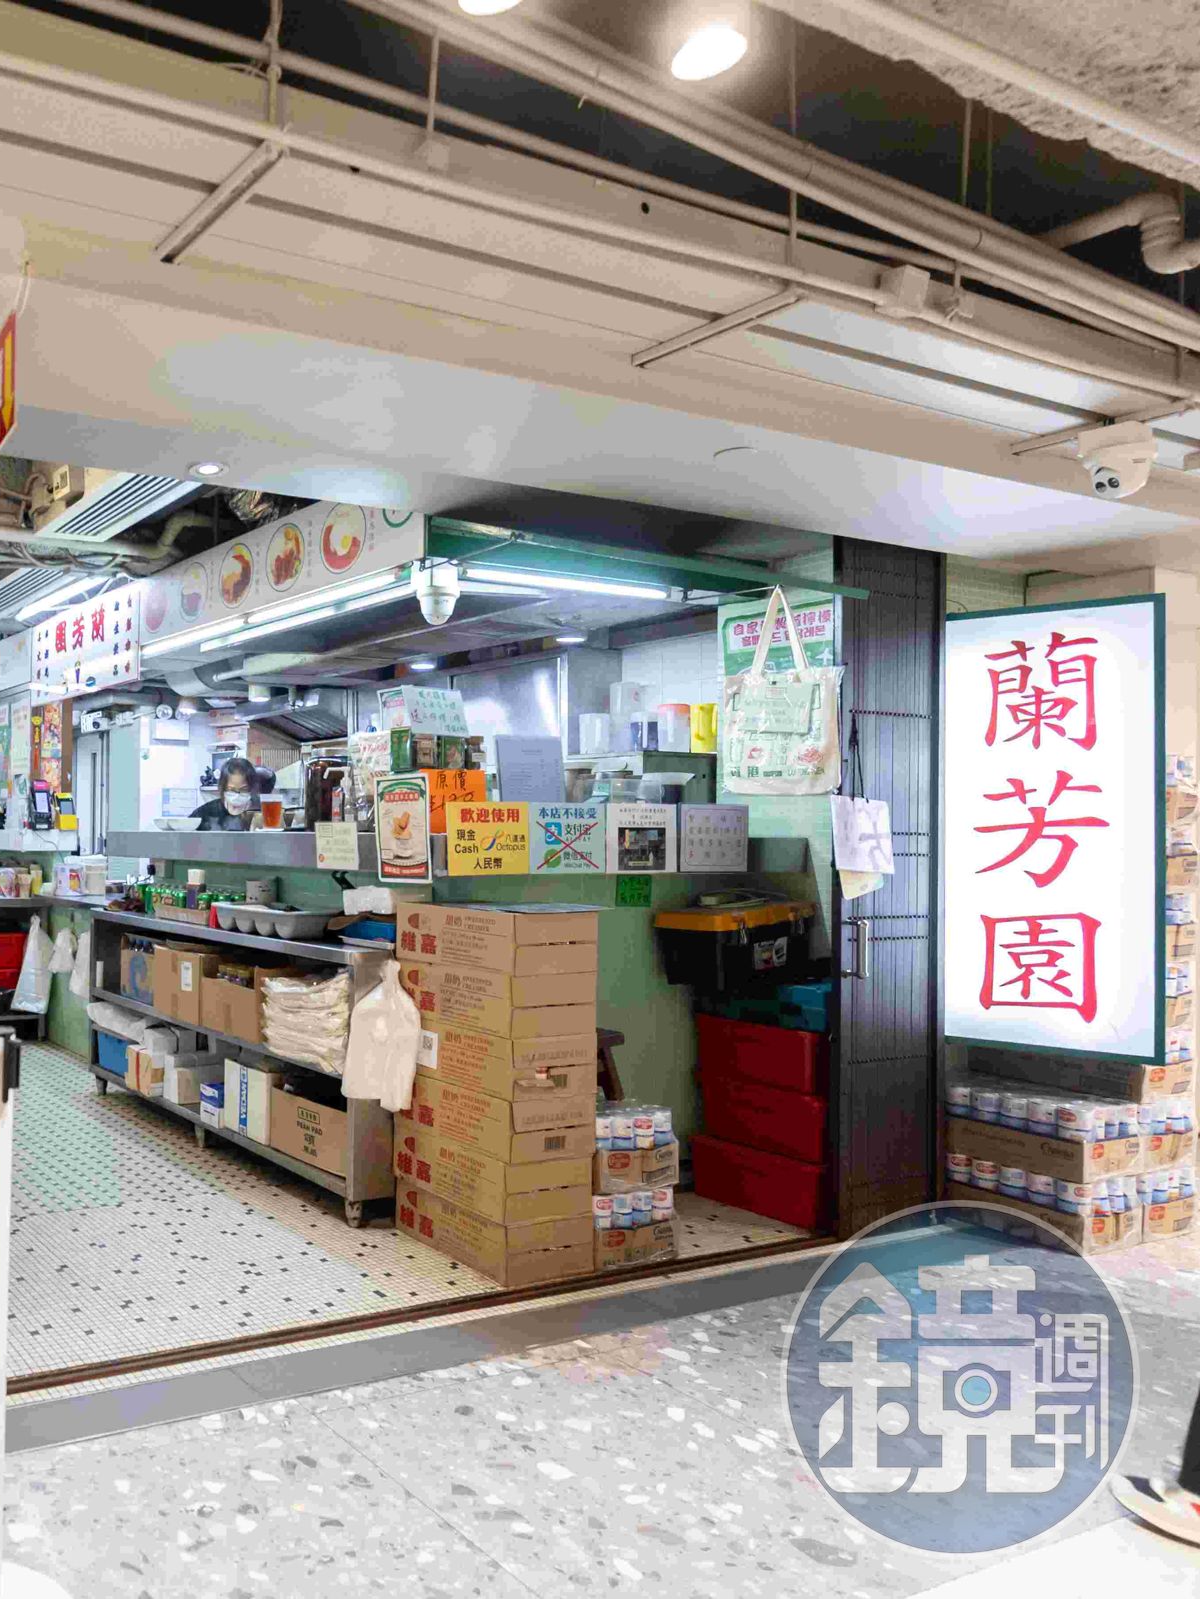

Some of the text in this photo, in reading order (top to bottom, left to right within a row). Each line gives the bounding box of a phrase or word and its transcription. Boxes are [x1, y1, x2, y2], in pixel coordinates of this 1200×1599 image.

[460, 808, 520, 823] 歡迎使用
[538, 807, 598, 820] 本店不接受
[973, 631, 1110, 1024] 蘭芳園
[456, 829, 476, 840] 現金
[454, 843, 526, 854] Cash Octopus
[474, 857, 503, 870] 人民幣
